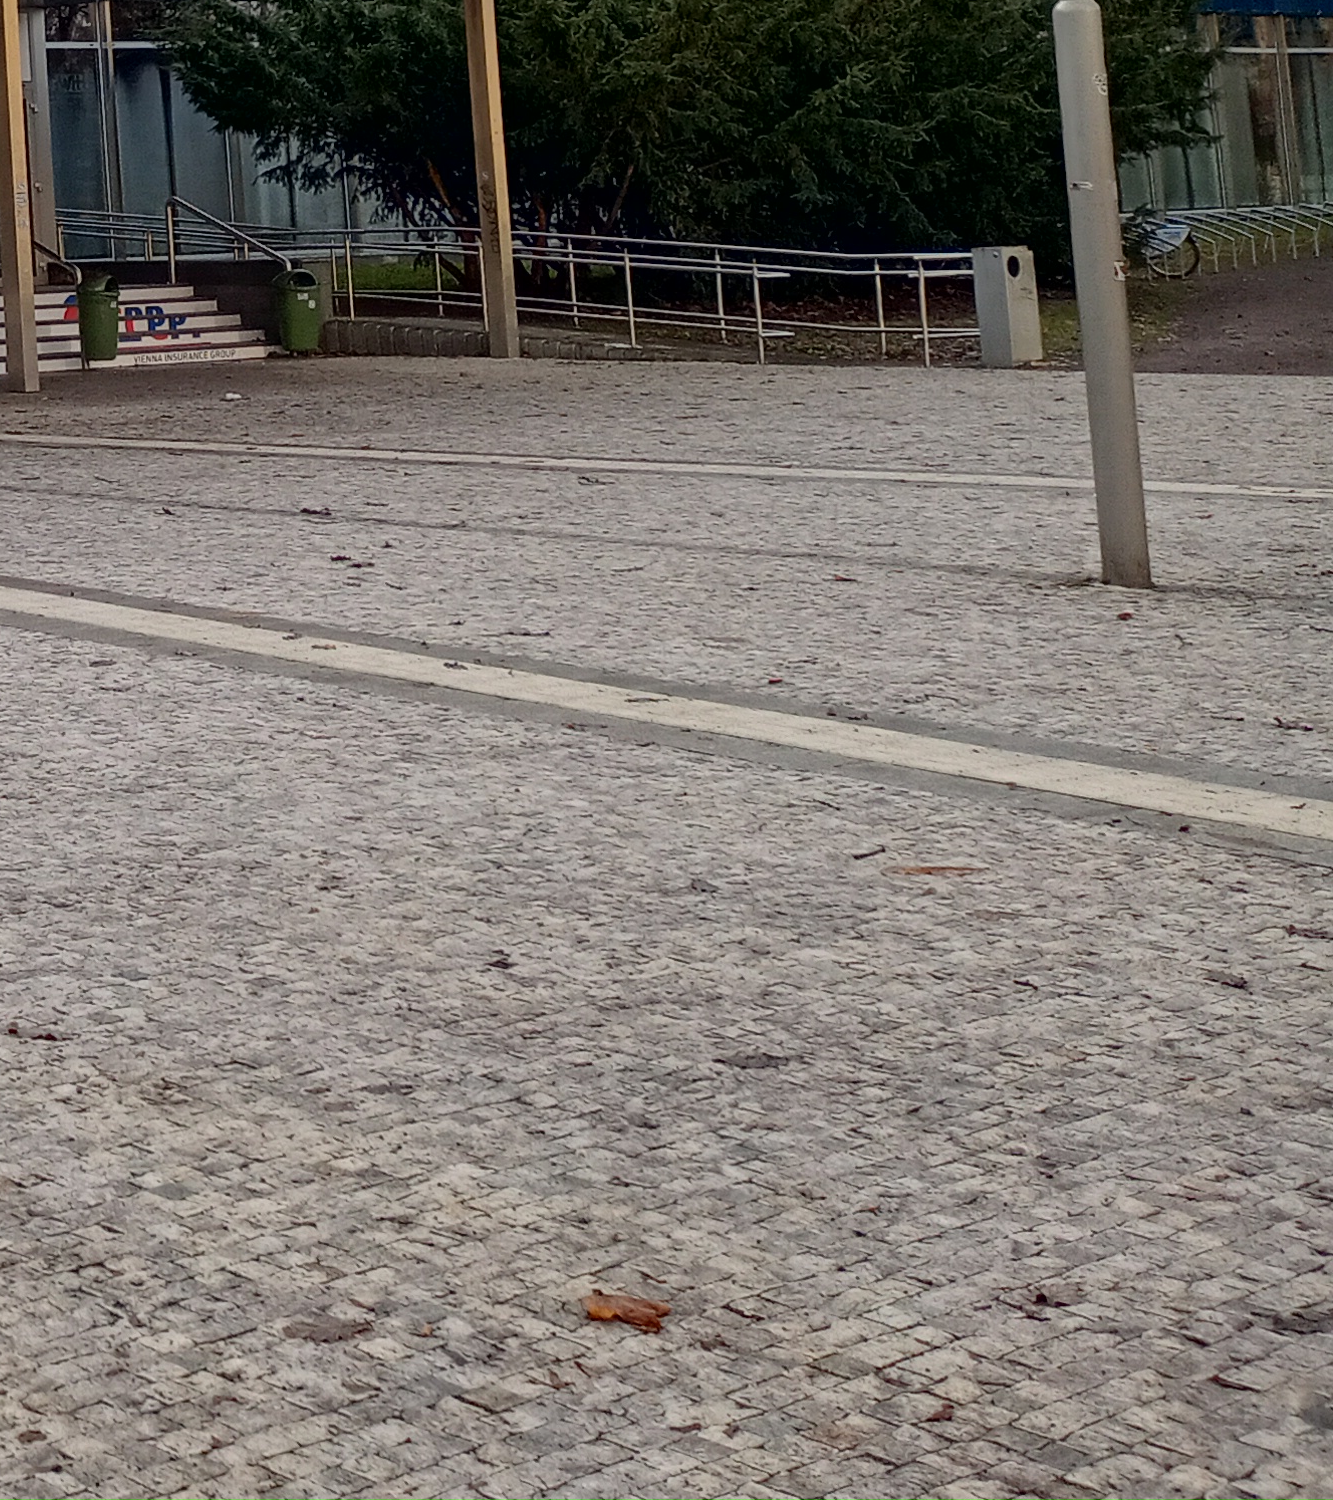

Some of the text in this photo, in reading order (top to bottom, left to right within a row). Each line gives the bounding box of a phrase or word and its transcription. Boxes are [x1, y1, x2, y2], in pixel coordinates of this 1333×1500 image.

[133, 348, 236, 365] VIENNA INSURANCE GROUP
